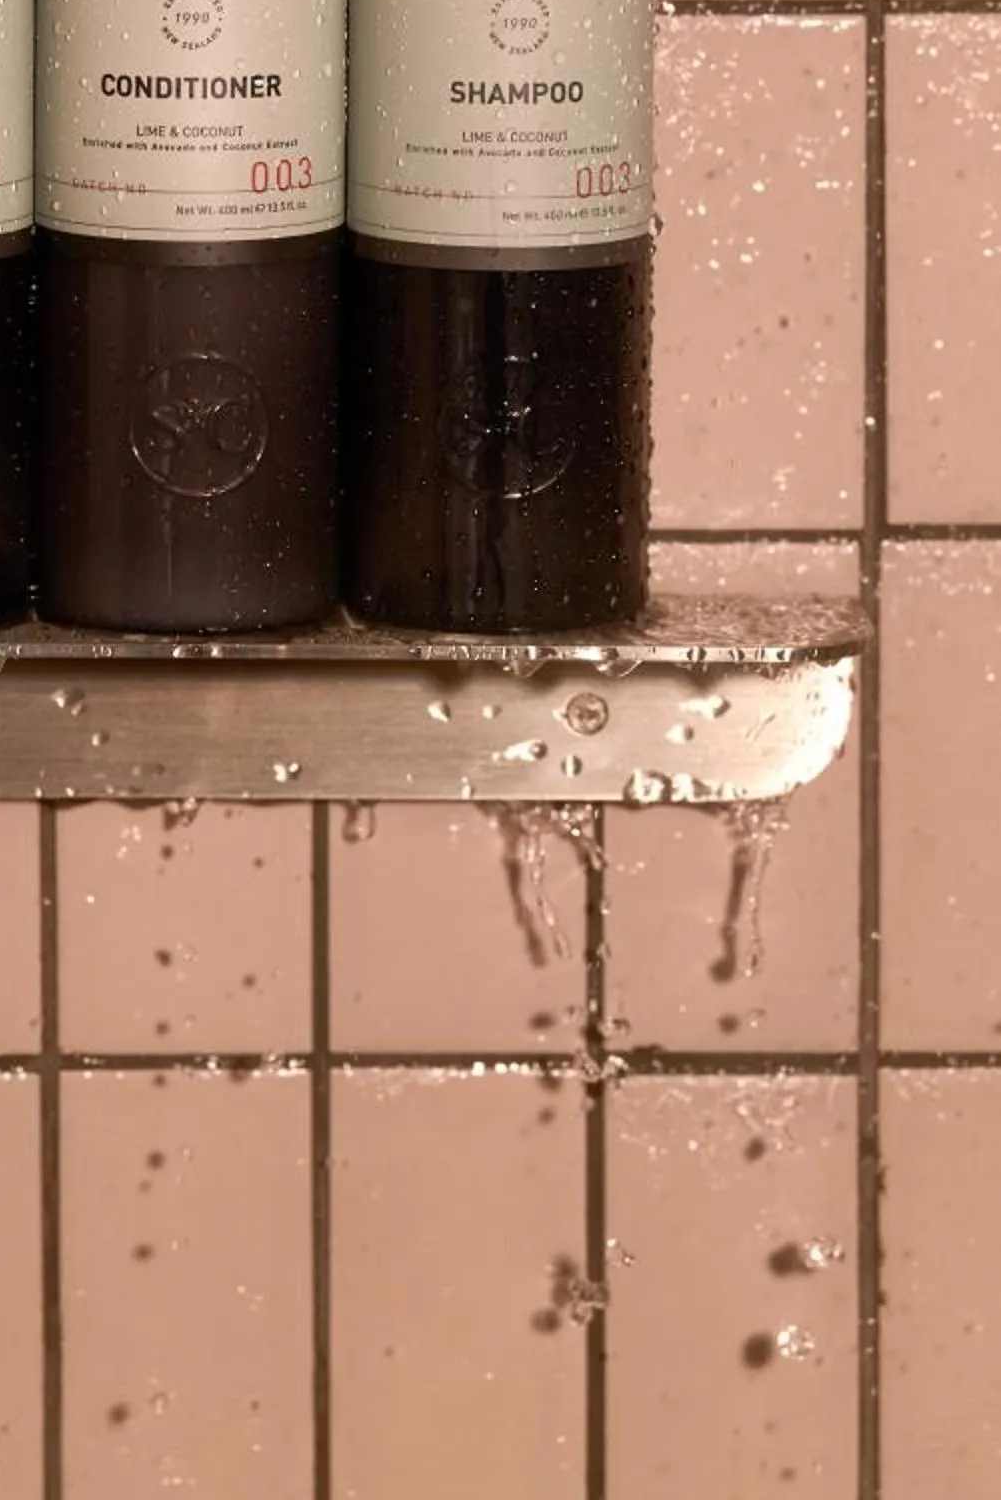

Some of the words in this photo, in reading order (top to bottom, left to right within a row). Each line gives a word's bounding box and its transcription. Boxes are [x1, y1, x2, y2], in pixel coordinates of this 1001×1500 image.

[176, 11, 210, 25] 1990
[503, 17, 538, 30] 1990
[101, 73, 282, 99] CONDITIONER
[450, 81, 583, 105] SHAMPOO
[136, 125, 166, 137] LIME
[170, 126, 179, 137] &
[183, 125, 243, 138] COCONUT
[462, 131, 492, 143] LIME
[510, 130, 568, 143] COCONUT
[251, 156, 312, 193] 003
[576, 161, 631, 198] 003
[177, 205, 194, 214] Net
